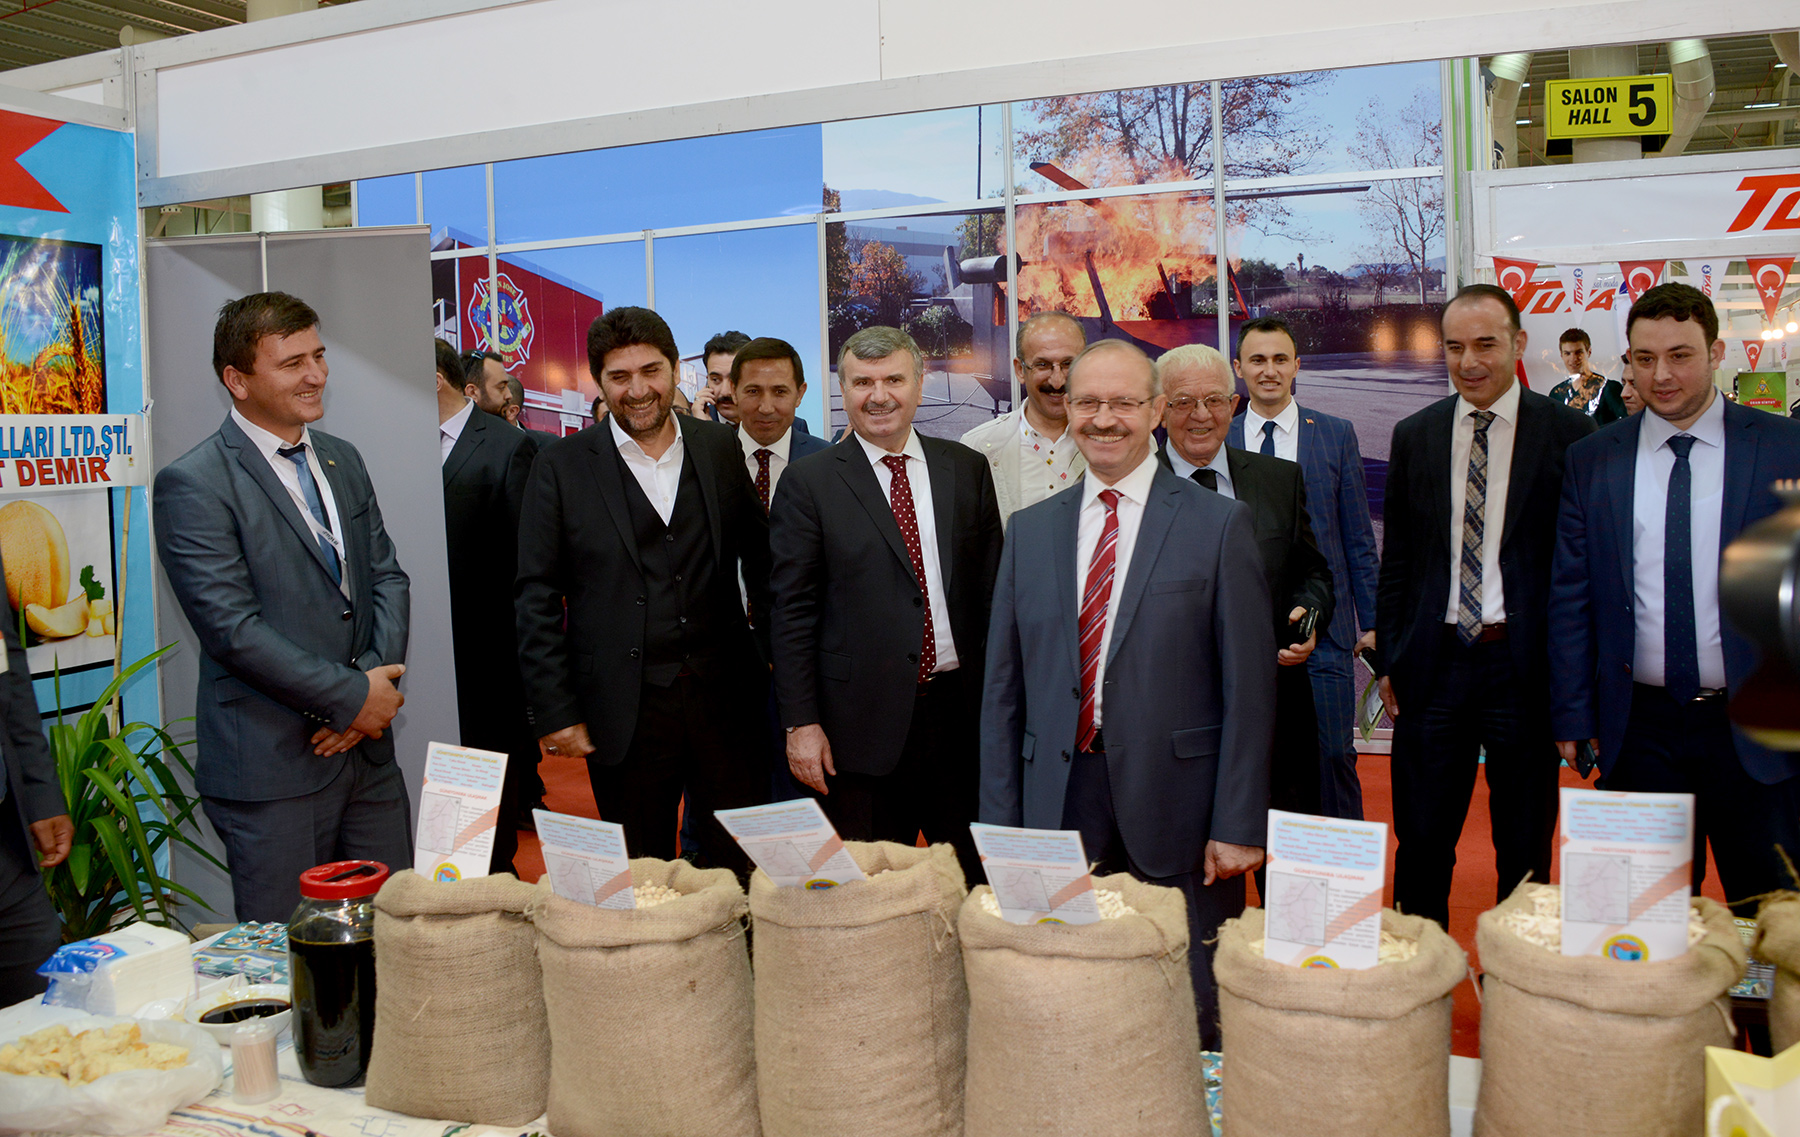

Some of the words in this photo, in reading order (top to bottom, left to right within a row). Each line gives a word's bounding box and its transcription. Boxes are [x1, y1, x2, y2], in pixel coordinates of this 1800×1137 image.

[1561, 87, 1617, 106] SALON
[1628, 83, 1657, 127] 5
[1568, 108, 1611, 125] HALL
